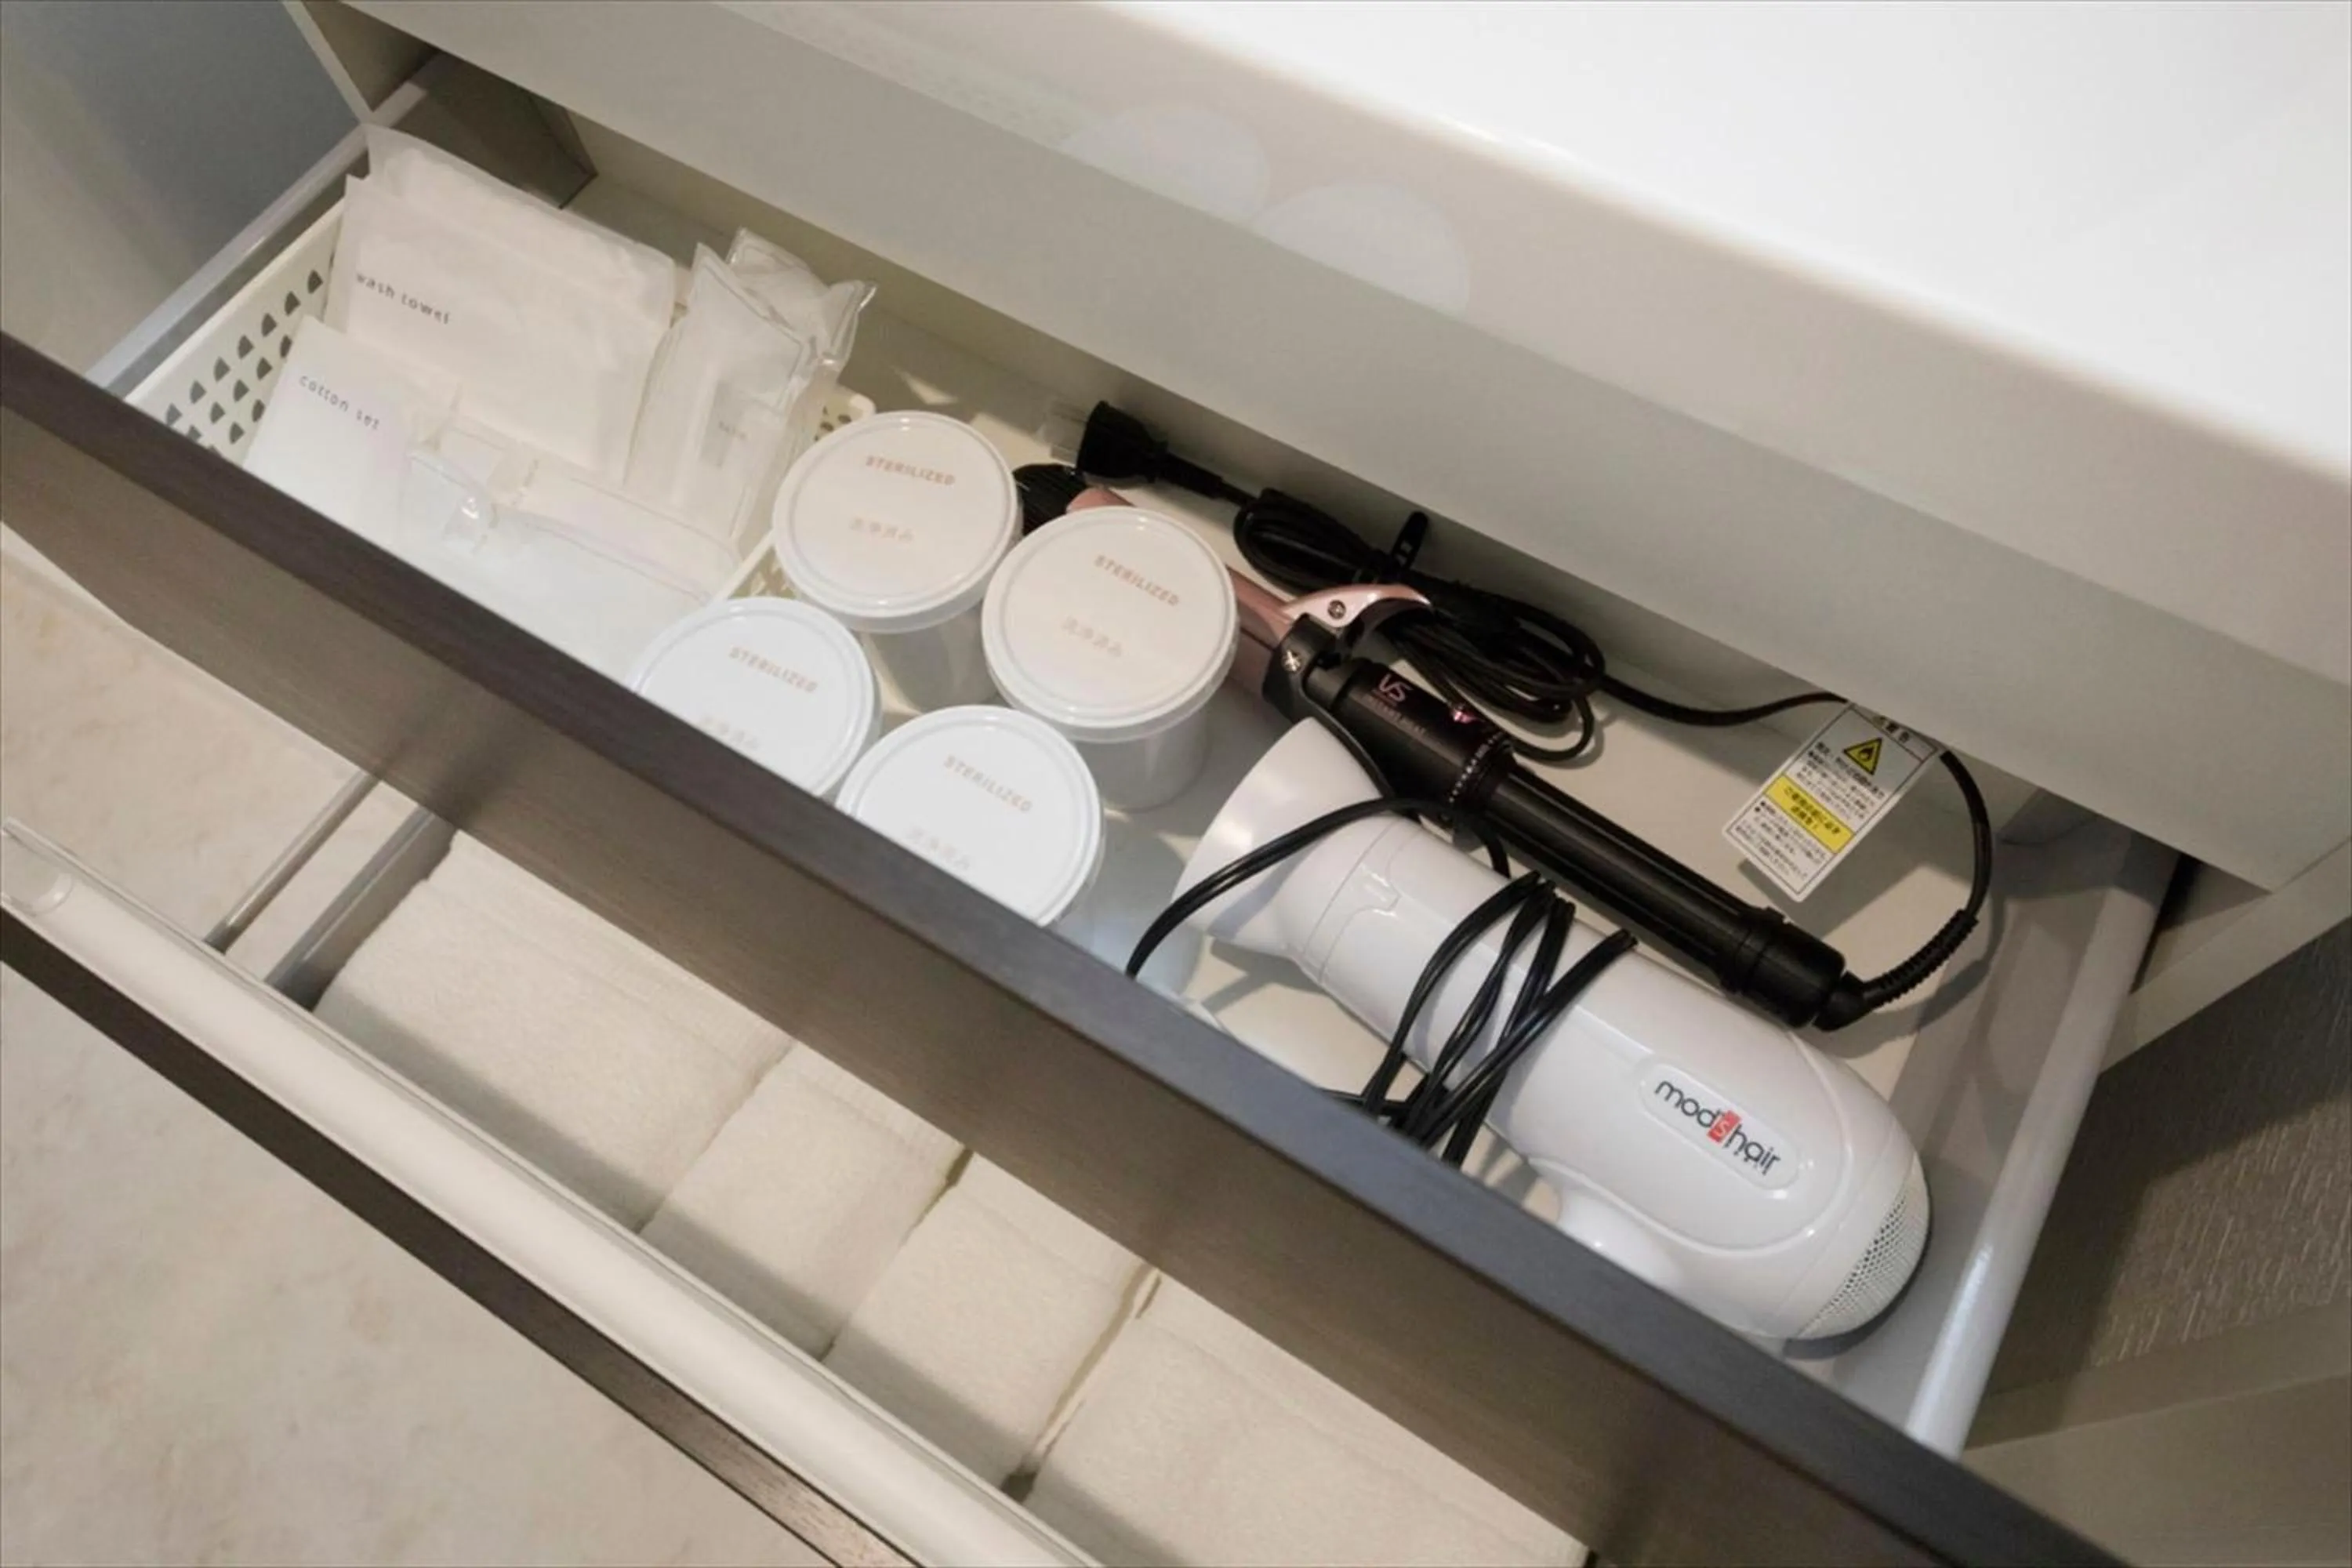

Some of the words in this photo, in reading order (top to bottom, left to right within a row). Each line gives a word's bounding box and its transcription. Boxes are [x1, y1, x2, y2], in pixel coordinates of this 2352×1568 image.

[356, 272, 396, 299] wash
[400, 294, 451, 325] towel
[299, 375, 350, 412] cotton
[356, 408, 381, 430] set
[865, 455, 956, 486] STERILIZED
[1094, 554, 1180, 607] STERILIZED
[728, 646, 818, 693] STERILIZED
[942, 755, 1033, 812] STERILIZED
[1723, 1123, 1782, 1176] hair
